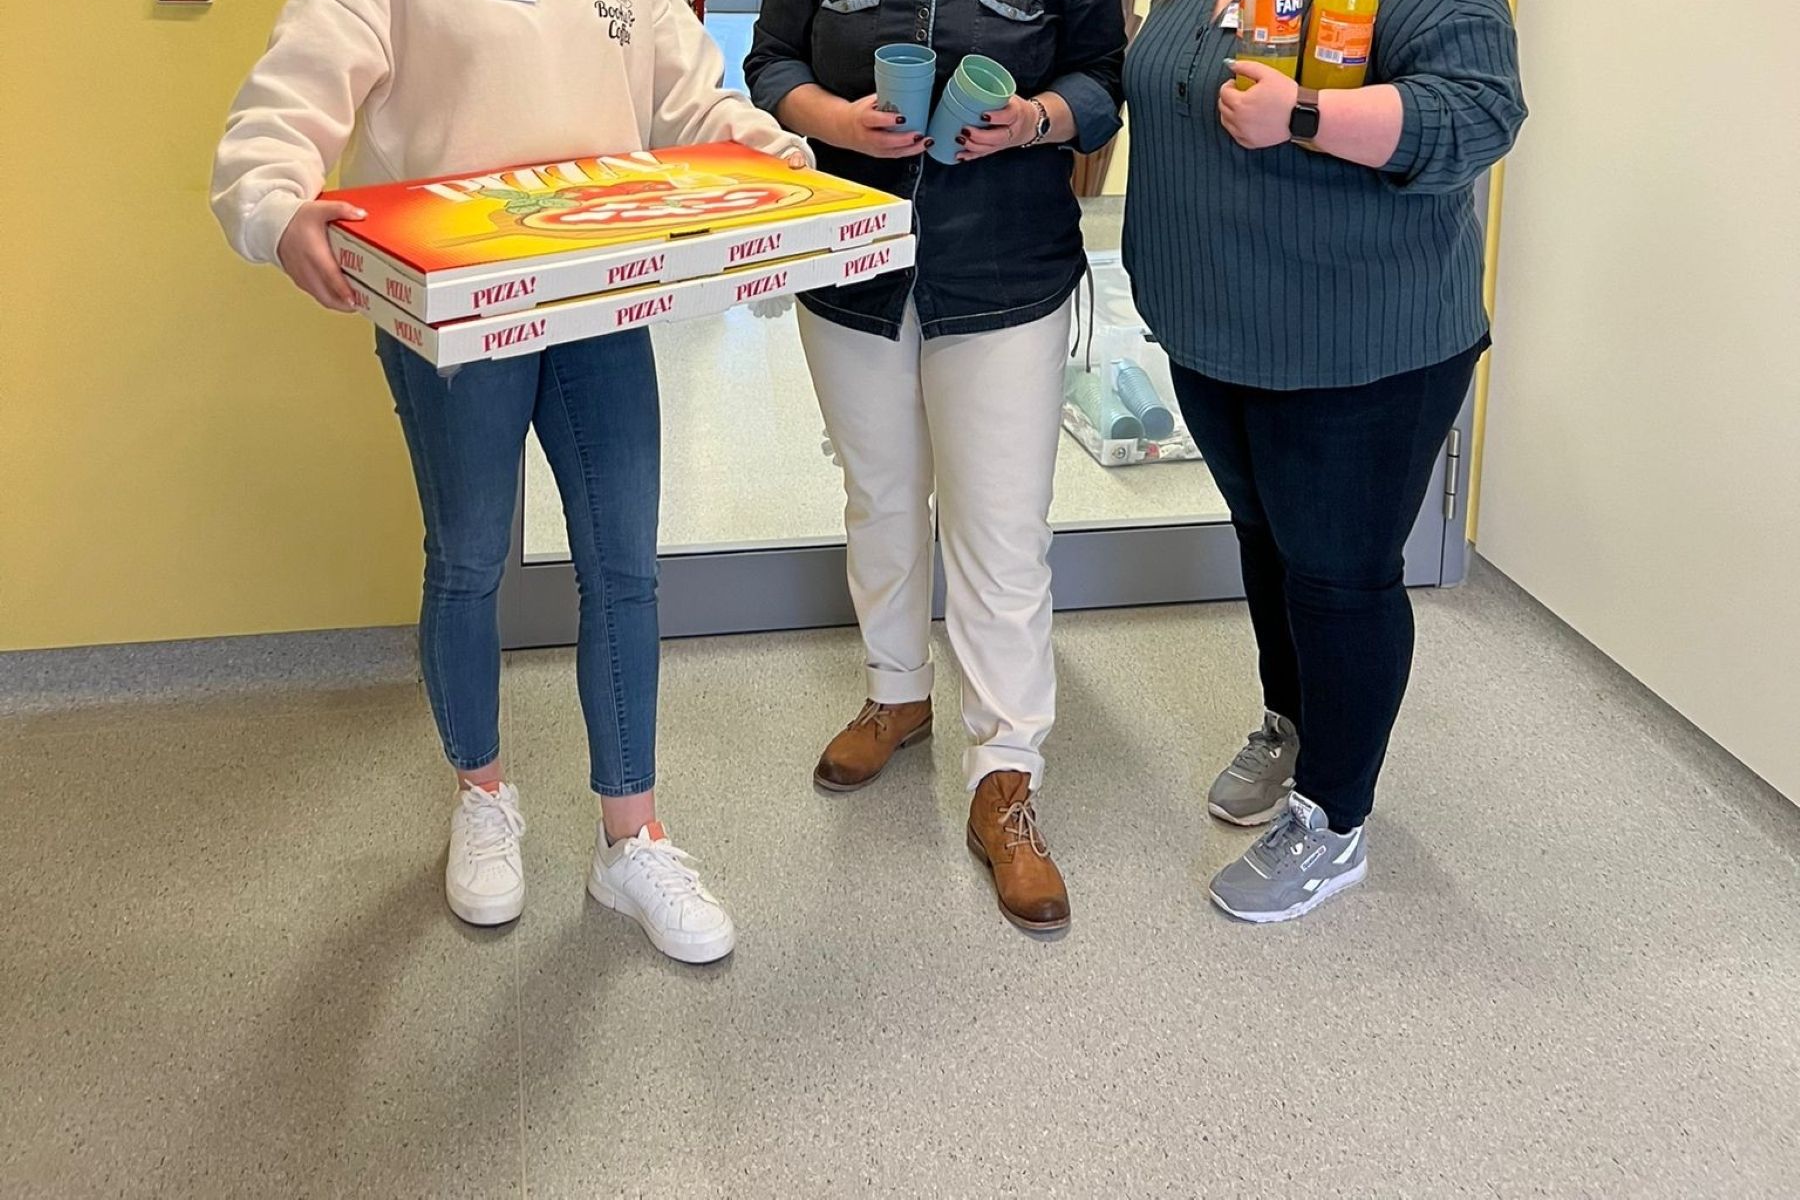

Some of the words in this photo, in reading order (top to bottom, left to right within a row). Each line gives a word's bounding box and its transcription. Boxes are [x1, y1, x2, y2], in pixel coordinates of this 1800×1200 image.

[838, 213, 887, 242] PIZZA!
[728, 233, 782, 262] PIZZA!
[845, 247, 891, 278] PIZZA!
[607, 254, 665, 285] PIZZA!
[472, 276, 537, 310] PIZZA!
[735, 271, 788, 301] PIZZA!
[616, 294, 674, 327] PIZZA!
[482, 319, 547, 353] PIZZA!
